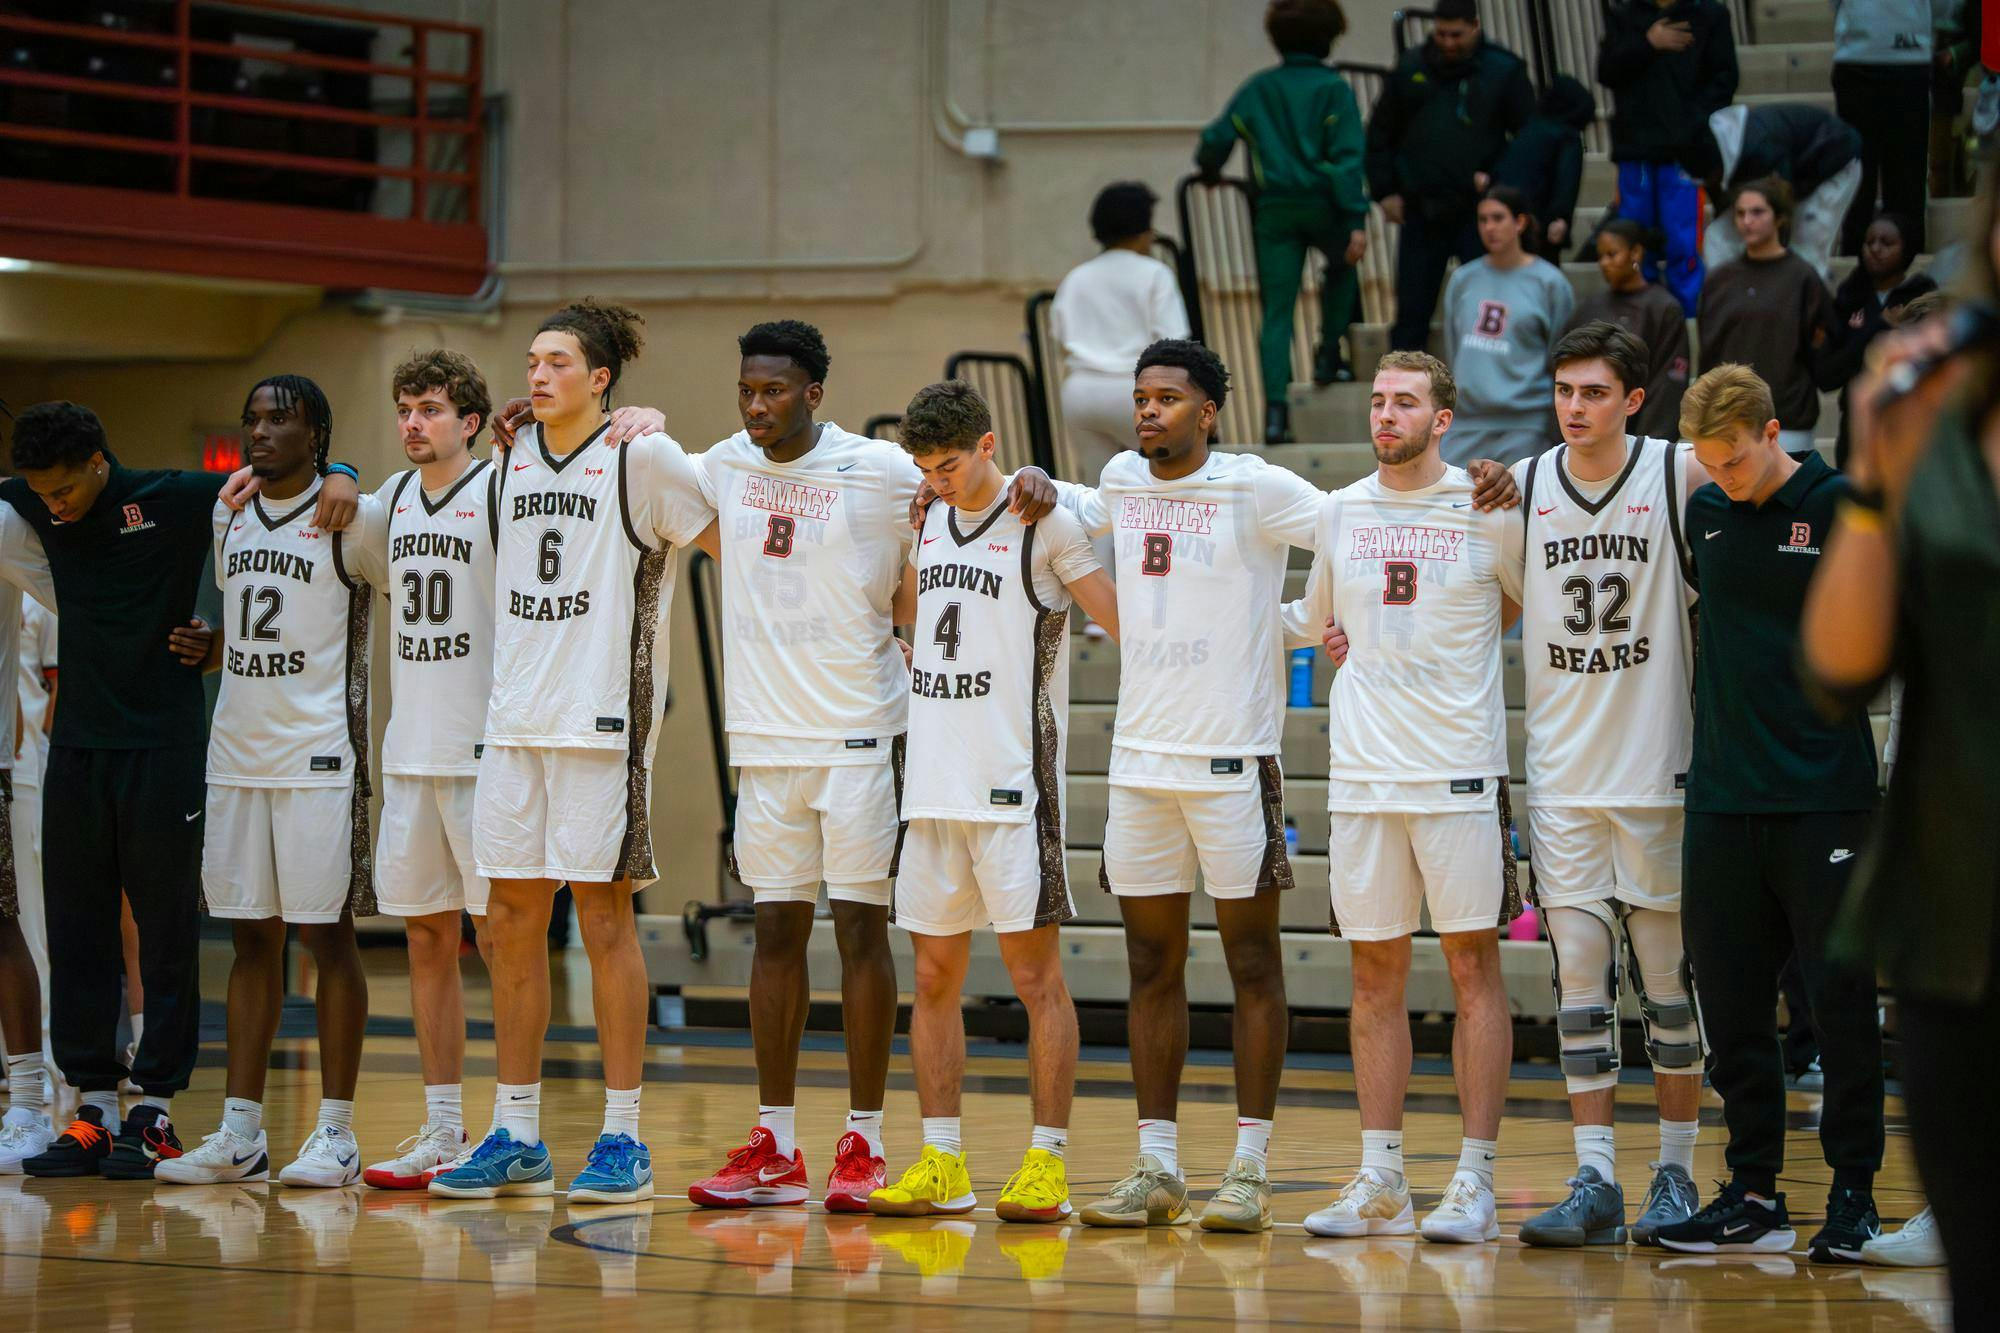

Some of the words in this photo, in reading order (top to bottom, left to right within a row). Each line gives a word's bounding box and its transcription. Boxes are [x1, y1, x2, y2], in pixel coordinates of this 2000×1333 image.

[1475, 300, 1508, 338] B
[123, 503, 143, 527] B
[455, 510, 469, 519] Ivy
[512, 491, 597, 522] BROWN
[742, 474, 838, 521] FAMILY
[1120, 496, 1217, 535] FAMILY
[1627, 505, 1642, 515] Ivy
[120, 520, 156, 534] BASKETBALL
[298, 530, 312, 540] Ivy
[763, 514, 796, 559] B
[1350, 526, 1464, 562] FAMILY
[1790, 522, 1811, 546] B
[227, 548, 314, 584] BROWN
[392, 532, 473, 565] BROWN
[537, 528, 564, 584] 6
[988, 543, 1002, 553] Ivy
[1142, 532, 1172, 577] B
[1543, 533, 1649, 571] BROWN
[1778, 545, 1820, 555] BASKETBALL
[402, 569, 453, 626] 30
[918, 563, 1003, 600] BROWN
[1383, 561, 1418, 605] B
[239, 585, 284, 642] 12
[509, 589, 590, 622] BEARS
[1562, 572, 1631, 635] 32
[933, 601, 962, 661] 4
[227, 645, 305, 678] BEARS
[1547, 636, 1650, 674] BEARS
[911, 667, 992, 700] BEARS
